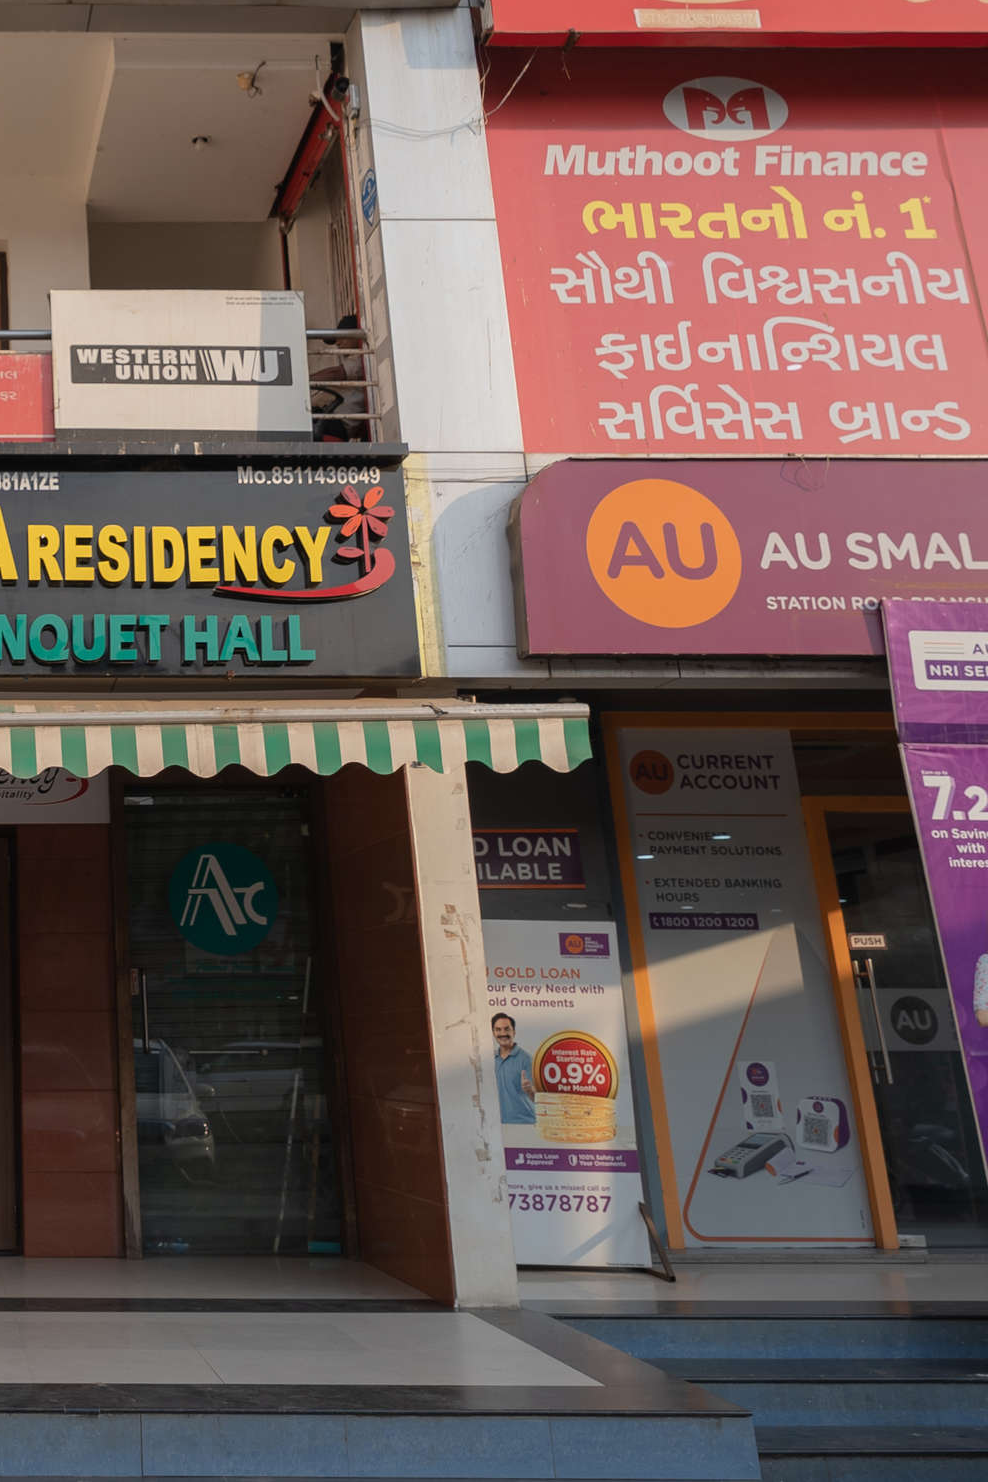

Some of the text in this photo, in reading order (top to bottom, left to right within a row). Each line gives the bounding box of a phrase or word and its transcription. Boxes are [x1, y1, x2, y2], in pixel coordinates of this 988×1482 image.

[543, 144, 928, 176] Muthoot Finance
[582, 186, 808, 239] ભારતનો
[550, 250, 970, 305] સૌથી વિશ્વસનીય
[76, 349, 197, 365] WESTERN
[115, 365, 197, 381] UNION
[210, 350, 280, 382] WU
[829, 401, 971, 444] બ્રાન્ડ
[27, 524, 331, 585] RESIDENCY
[607, 521, 718, 580] AU
[760, 532, 831, 570] AU
[766, 596, 846, 610] STATION
[183, 614, 316, 663] HALL
[930, 665, 959, 677] NRI
[677, 754, 775, 770] CURRENT
[636, 762, 668, 781] AU
[680, 775, 781, 790] ACCOUNT
[931, 829, 948, 839] on
[497, 837, 572, 857] LOAN
[650, 846, 782, 856] PAYMENT SOLUTIONS
[956, 842, 986, 854] with
[478, 863, 563, 880] ILABLE
[654, 878, 782, 889] EXTENDED BANKING
[656, 892, 700, 903] HOURS
[662, 918, 755, 928] 1800 1200 1200
[854, 937, 882, 945] PUSH
[494, 967, 536, 979] GOLD
[540, 968, 581, 979] LOAN
[487, 984, 605, 995] our Every Need with
[488, 998, 574, 1008] old Ornaments
[896, 1010, 932, 1030] AU
[572, 1084, 597, 1092] Month
